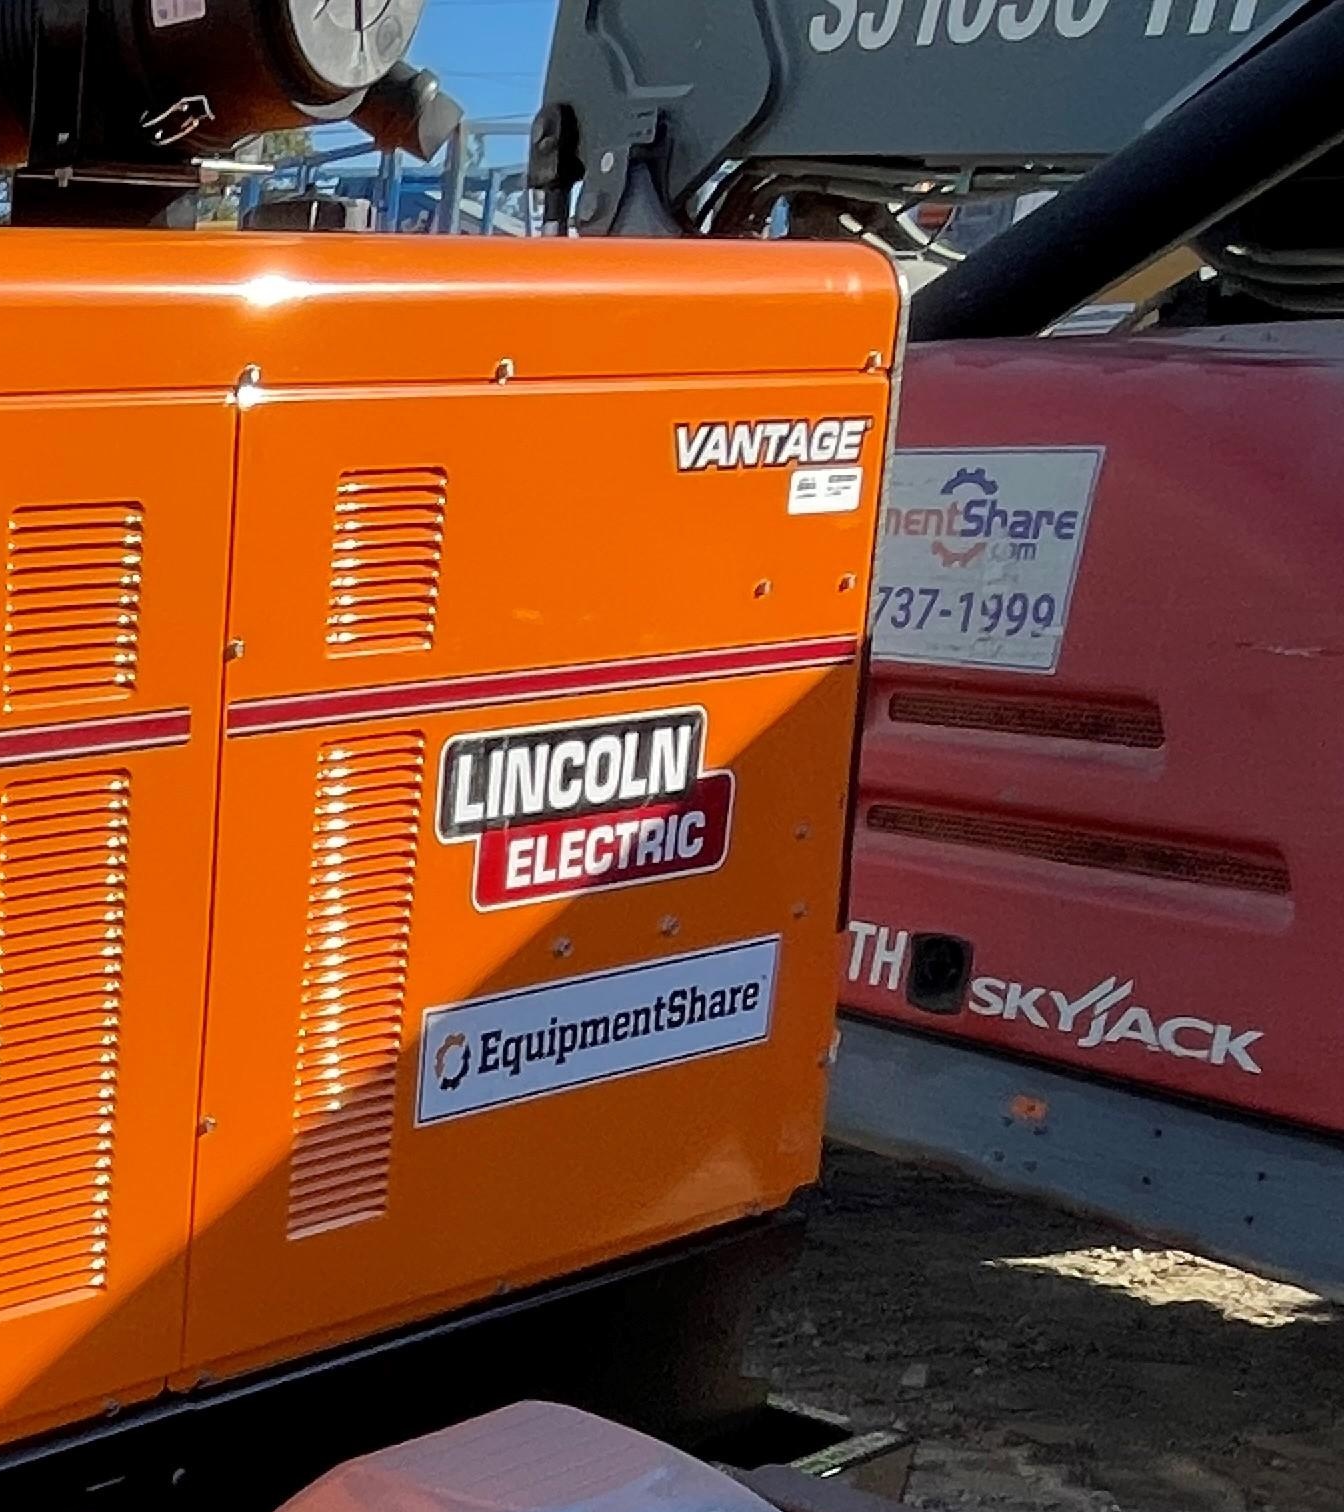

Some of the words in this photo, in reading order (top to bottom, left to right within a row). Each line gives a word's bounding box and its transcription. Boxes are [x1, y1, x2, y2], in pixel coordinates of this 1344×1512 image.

[675, 418, 867, 470] VANTAGE
[453, 724, 693, 824] LINCOLN
[504, 810, 707, 890] ELECTRIC
[848, 920, 909, 990] TH
[477, 978, 761, 1075] EquipmentShare
[968, 975, 1265, 1075] SKYJACK
